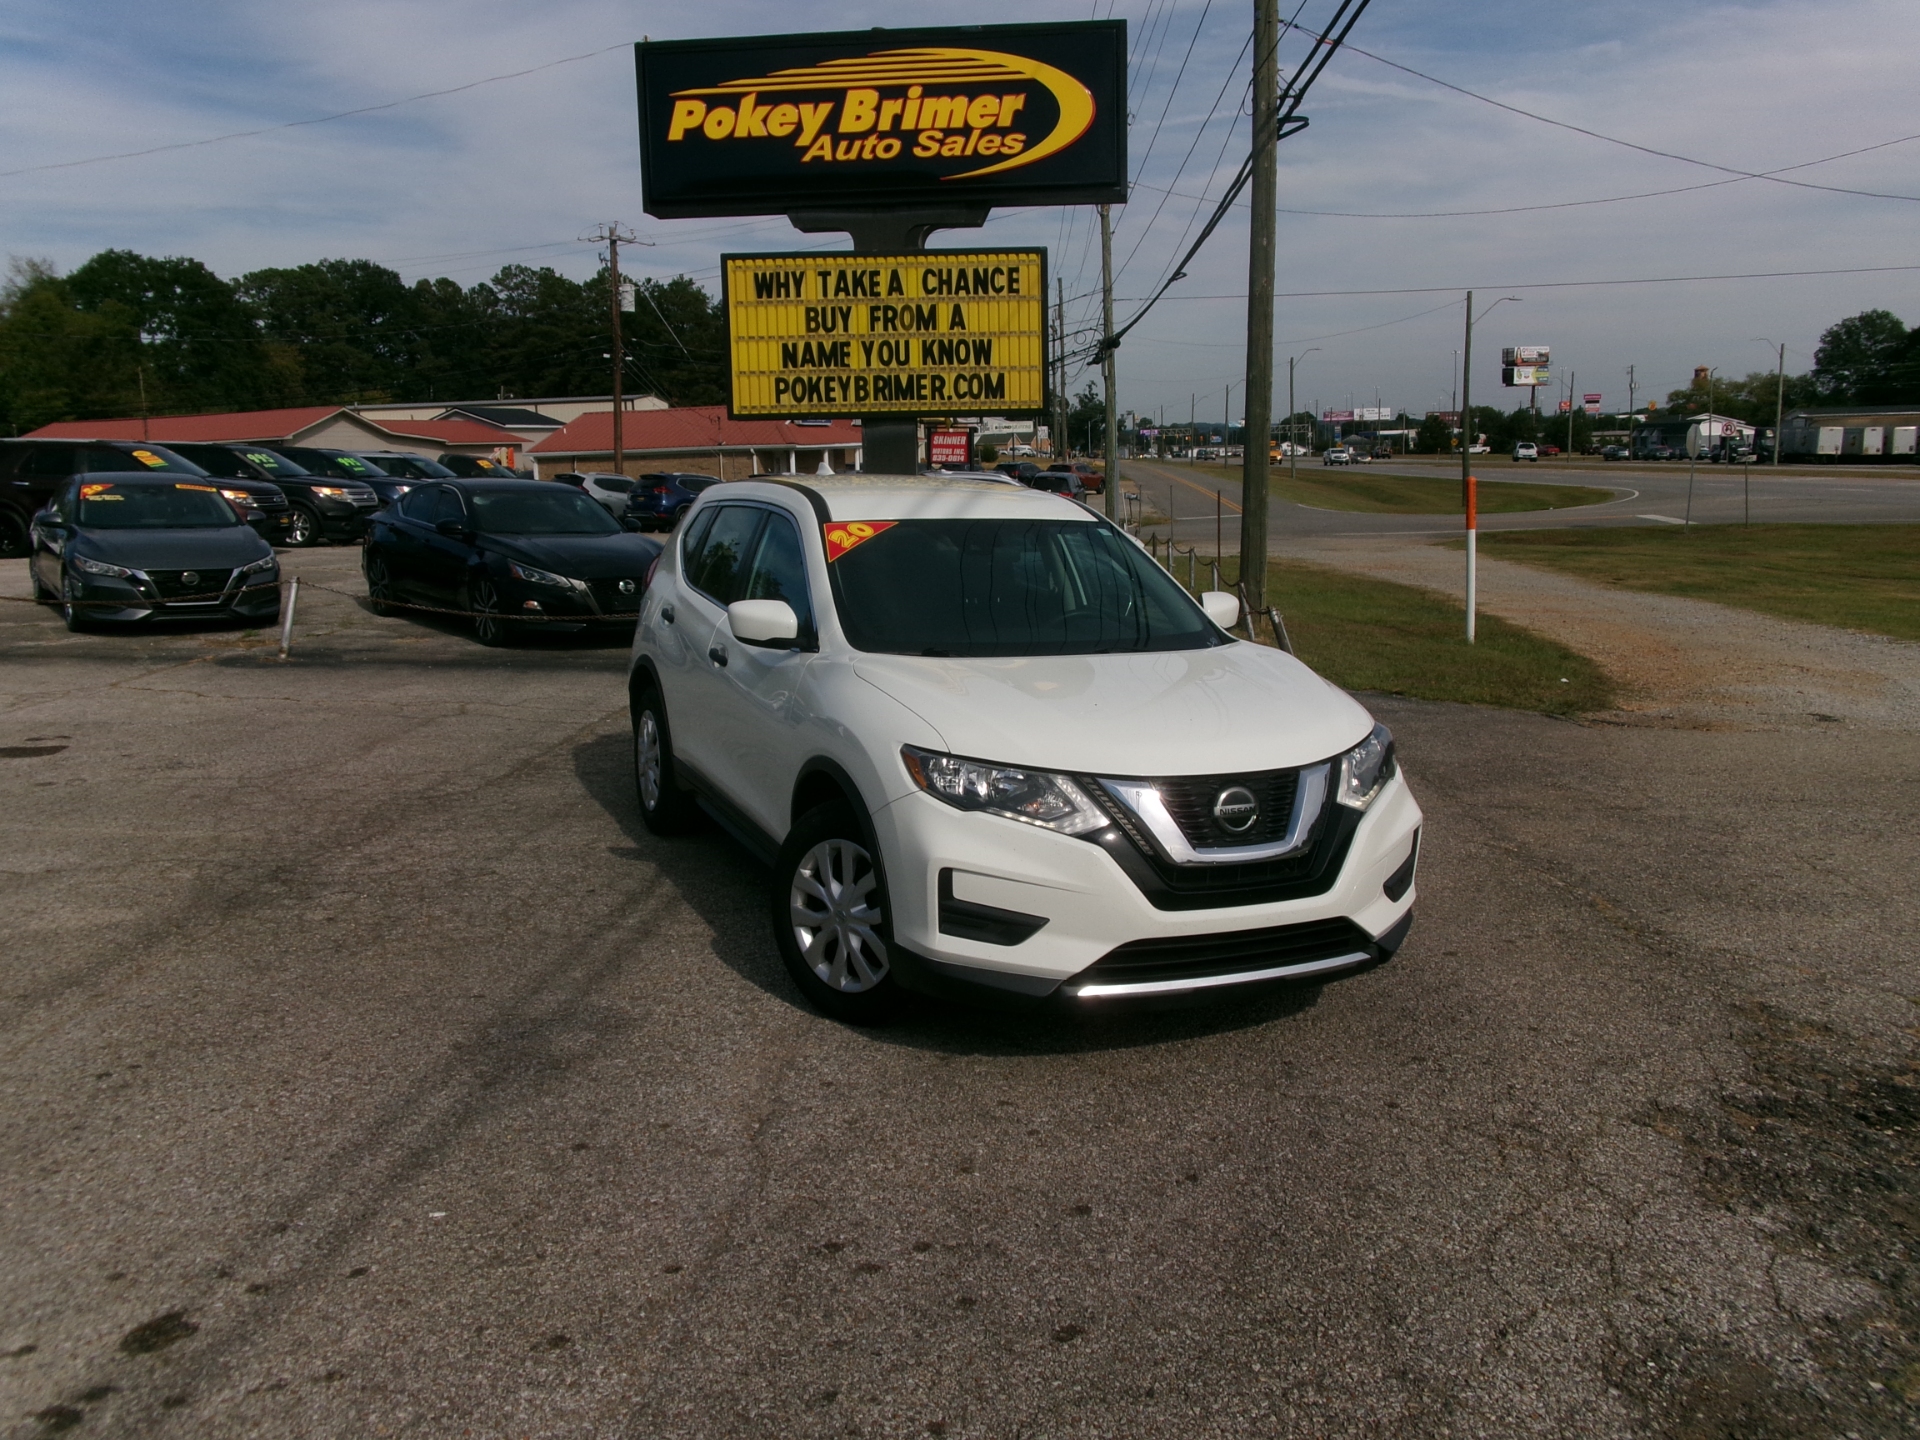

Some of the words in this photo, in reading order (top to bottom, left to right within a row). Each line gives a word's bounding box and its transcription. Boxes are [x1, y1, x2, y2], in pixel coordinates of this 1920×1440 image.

[667, 92, 834, 147] Pokey
[838, 85, 1026, 134] Brimer
[801, 132, 901, 162] Auto
[912, 129, 1026, 158] Sales
[753, 271, 805, 299] WHY
[817, 269, 881, 298] TAKE
[887, 268, 904, 297] A
[921, 266, 1021, 296] CHANCE
[805, 305, 852, 334] BUY
[869, 303, 937, 332] FROM
[949, 303, 966, 331] A
[781, 341, 851, 369] NAME
[860, 339, 911, 367] YOU
[921, 338, 992, 366] KNOW
[774, 372, 1005, 404] POKEYBRIMER.COM
[933, 435, 966, 445] SKINNER
[246, 453, 275, 463] 995
[83, 484, 103, 494] 20
[828, 522, 875, 548] 20
[1220, 807, 1256, 815] NISSAN
